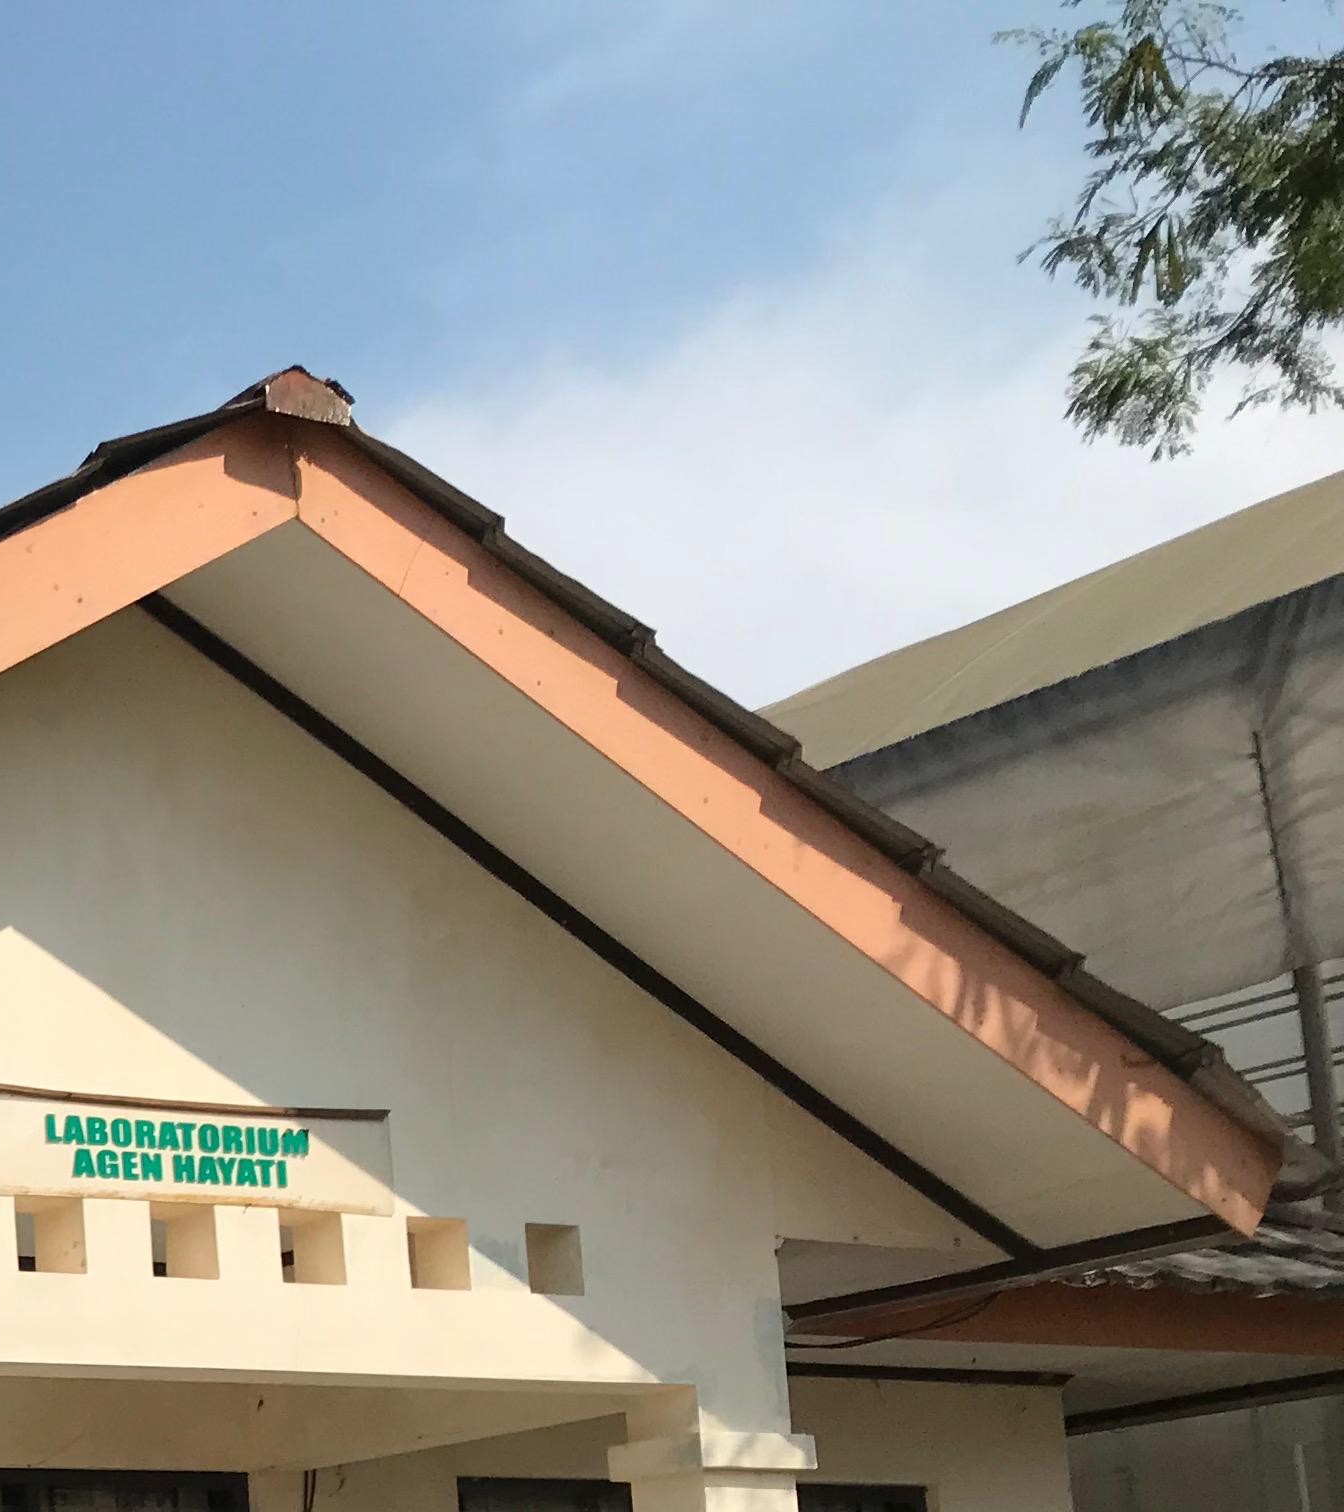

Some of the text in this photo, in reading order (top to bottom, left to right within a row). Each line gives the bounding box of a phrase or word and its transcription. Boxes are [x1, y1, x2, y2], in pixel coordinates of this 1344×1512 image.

[45, 1114, 310, 1156] LABORATORIUM
[72, 1149, 288, 1188] AGEN HAYATI
